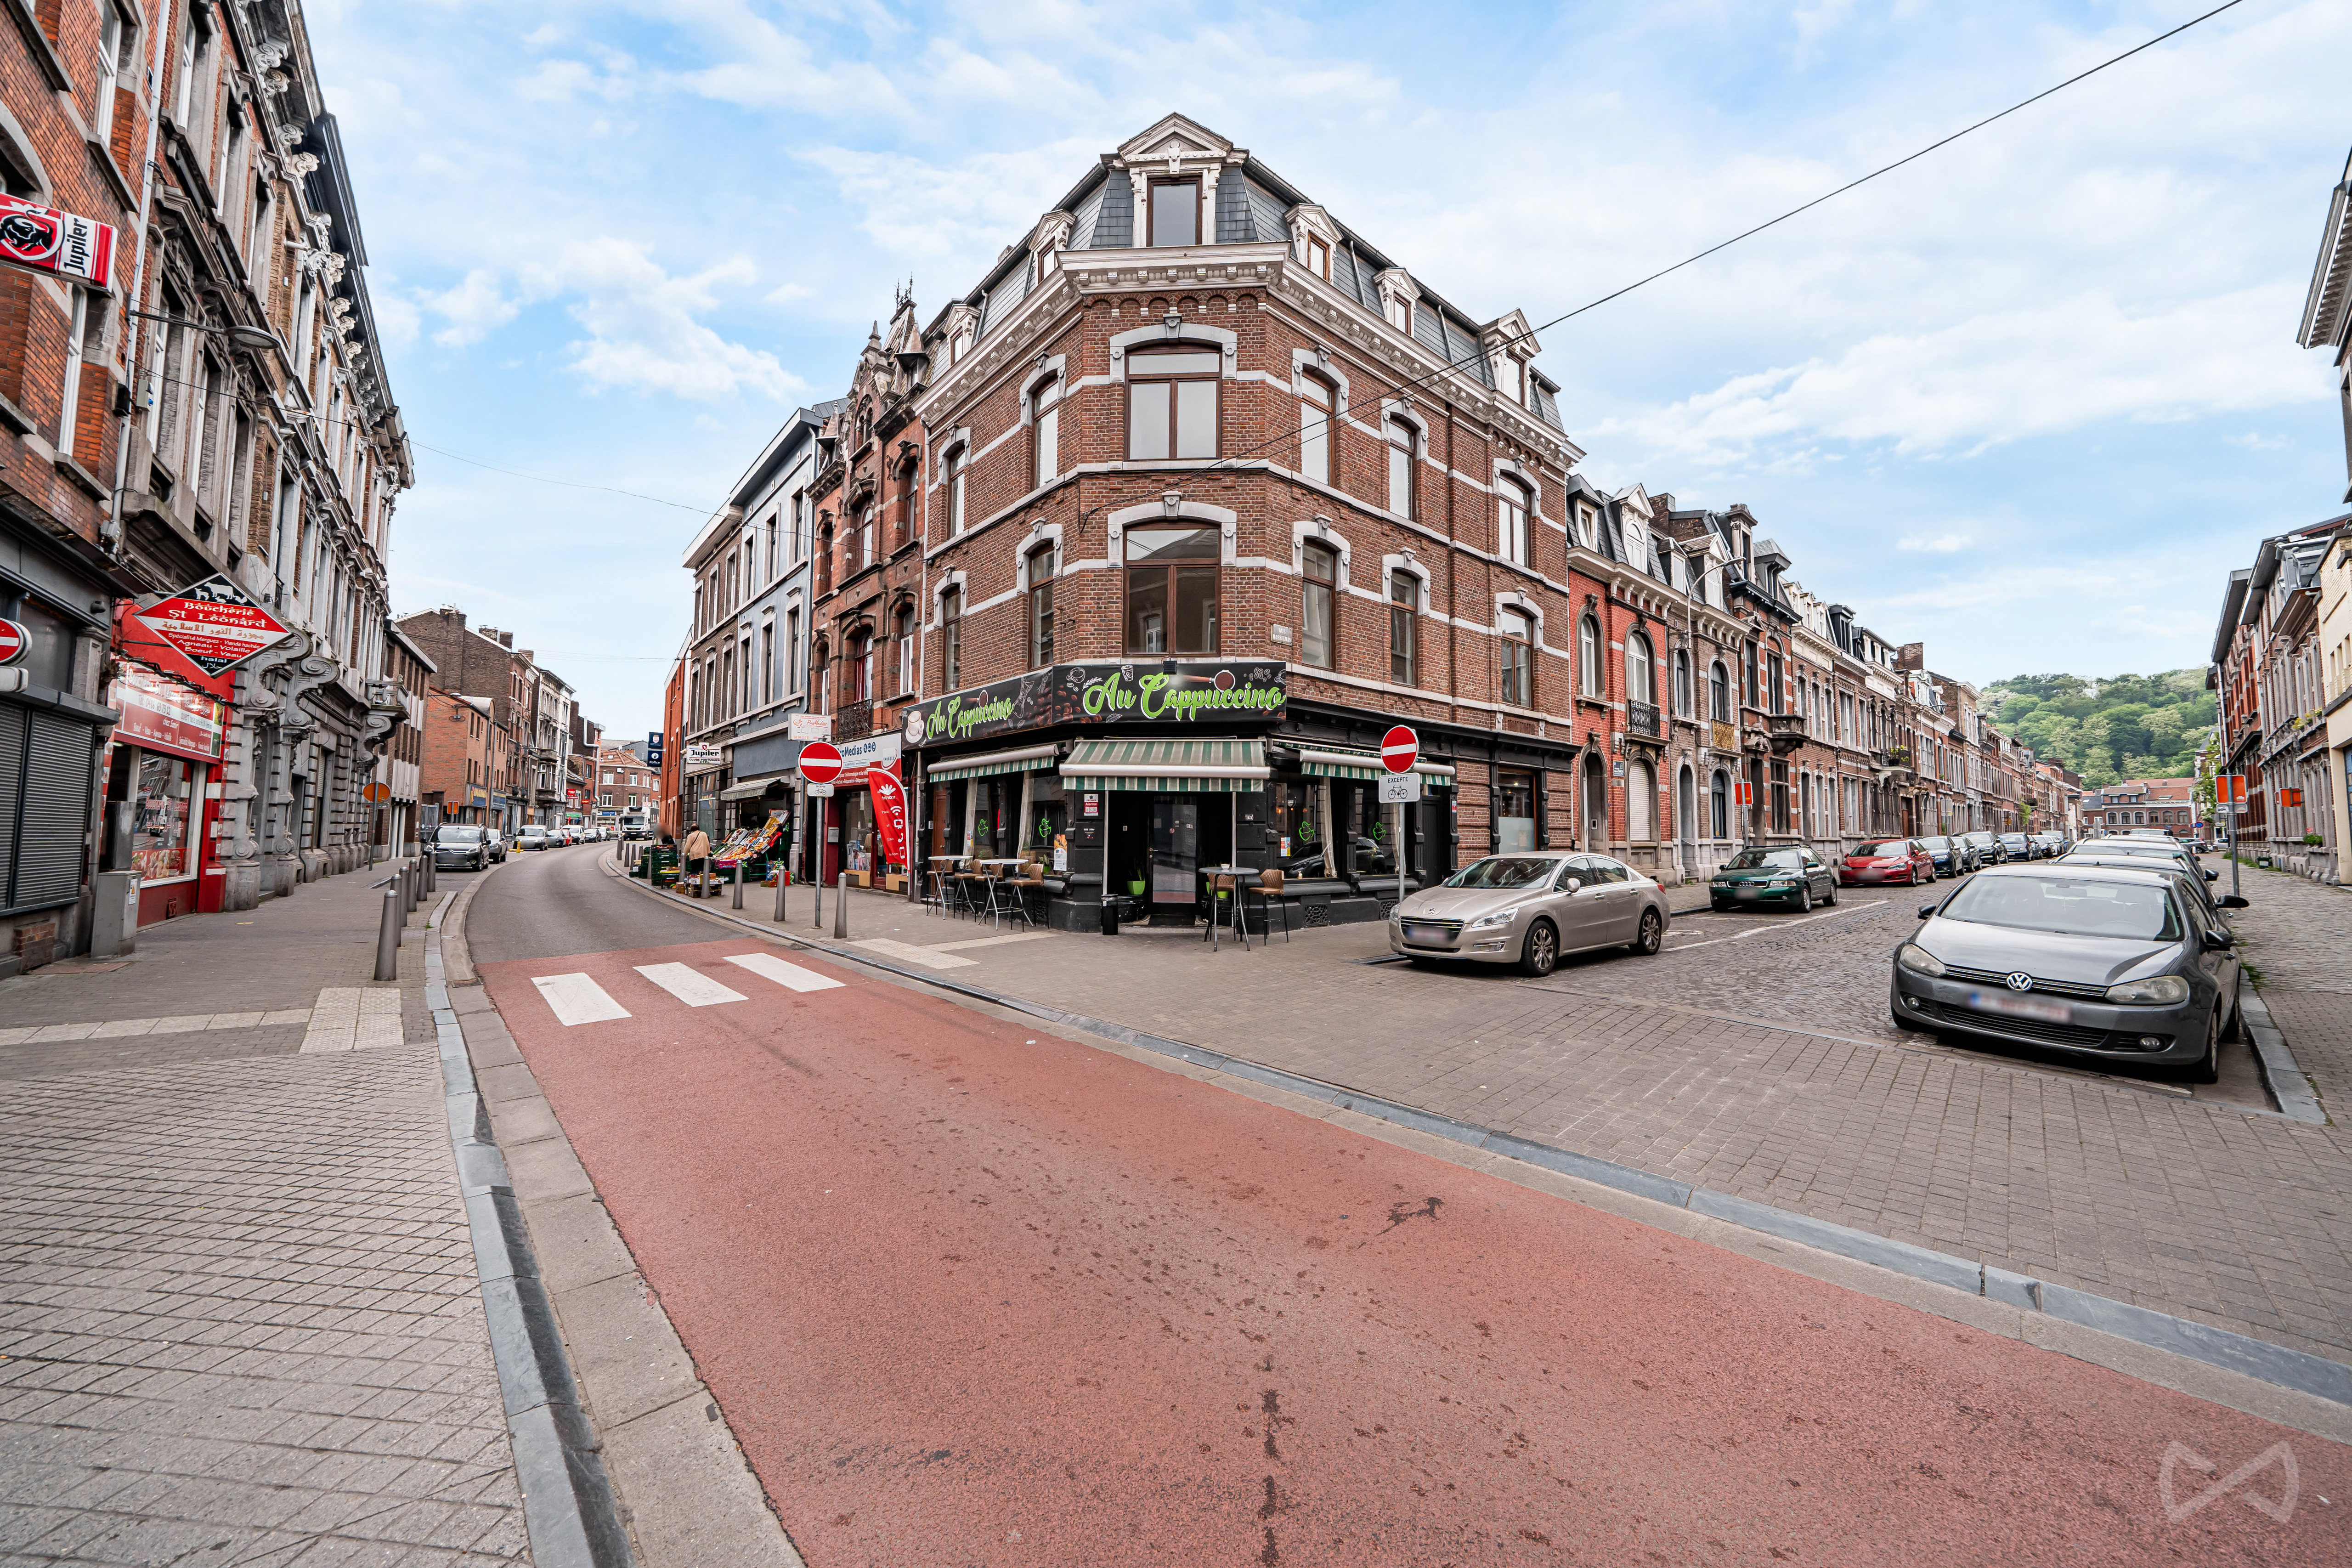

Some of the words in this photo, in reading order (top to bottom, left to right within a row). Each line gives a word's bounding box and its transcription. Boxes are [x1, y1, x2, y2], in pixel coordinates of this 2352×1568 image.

[64, 218, 90, 276] Jupiler
[169, 610, 187, 619] St
[184, 602, 254, 616] Boucherie
[177, 639, 212, 648] Agneau
[1272, 634, 1291, 642] MOSSELMAN
[1083, 672, 1137, 716] Au
[1139, 672, 1286, 722] Cappuccino
[926, 701, 947, 739] Au
[948, 696, 1014, 738] Cappuccino
